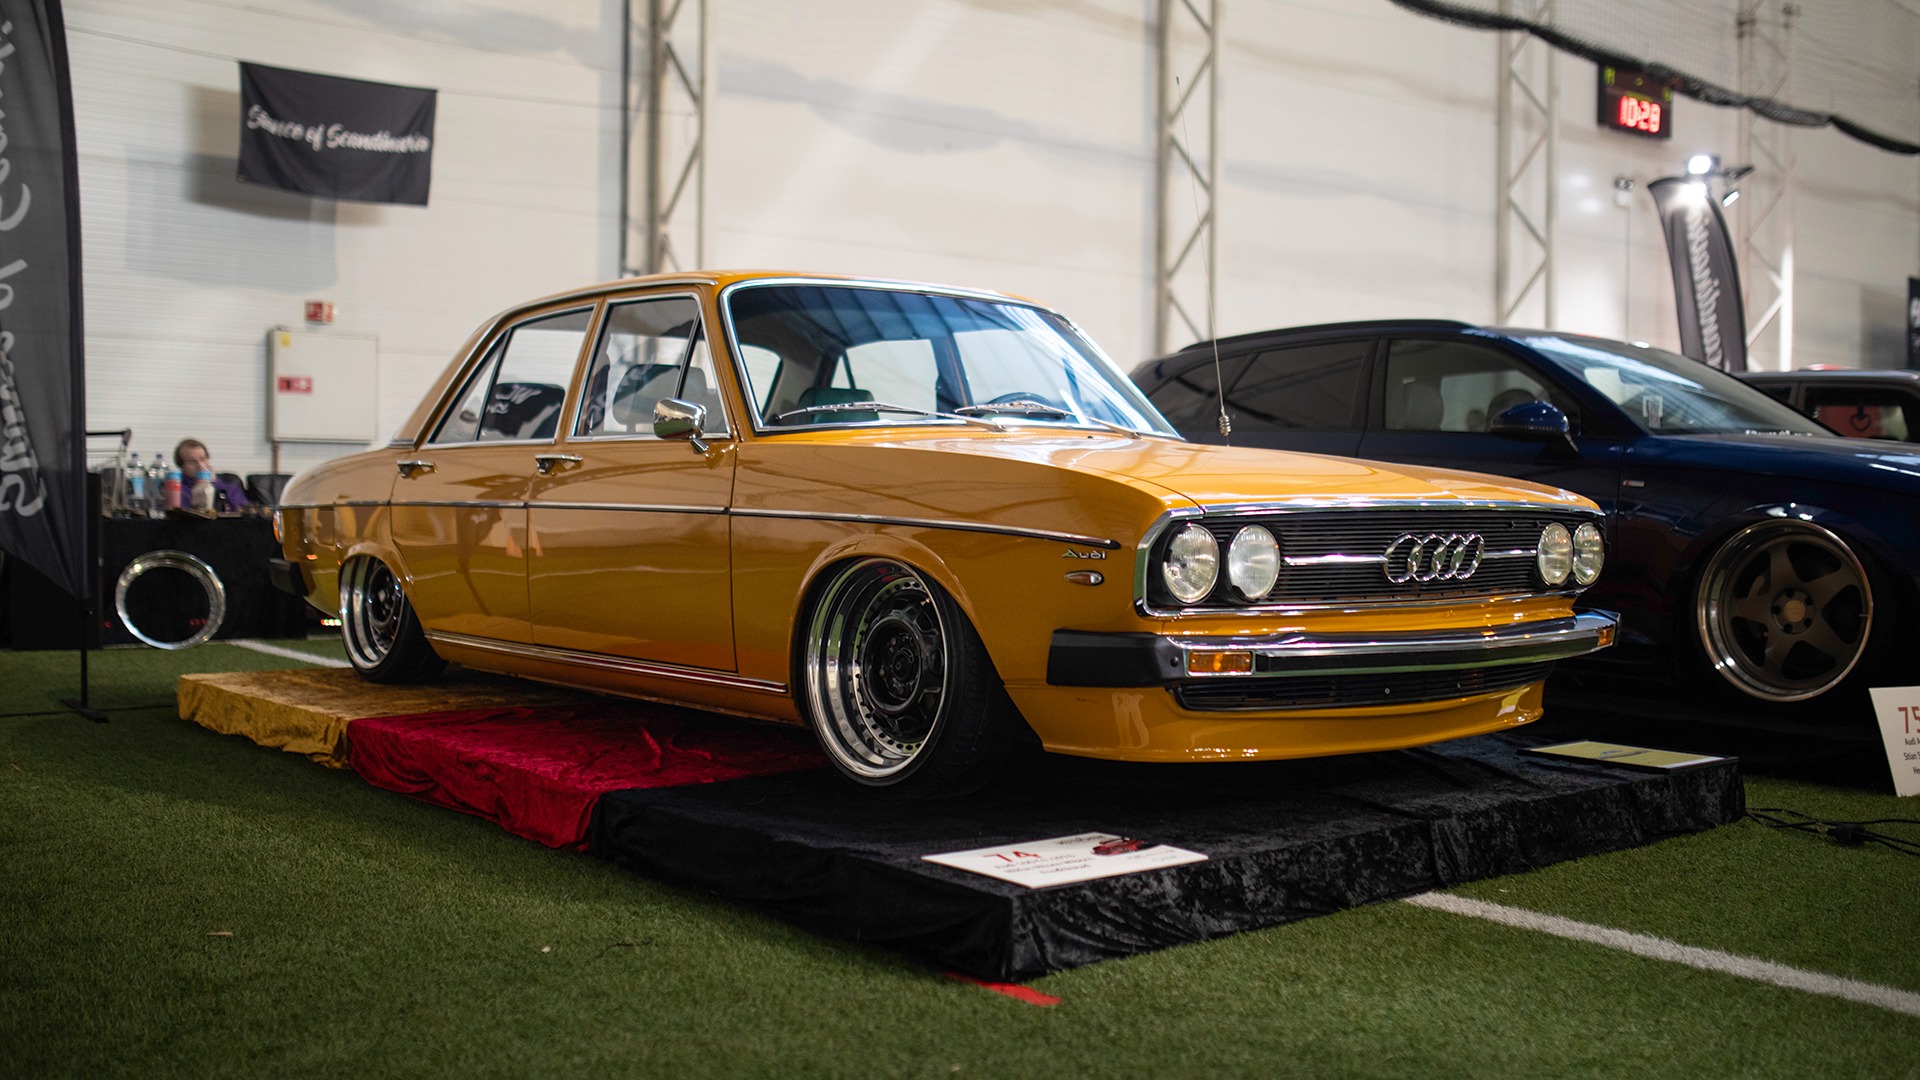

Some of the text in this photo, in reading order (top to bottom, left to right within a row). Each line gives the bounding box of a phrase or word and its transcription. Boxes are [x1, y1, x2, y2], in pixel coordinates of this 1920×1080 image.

[305, 123, 325, 152] of
[1062, 549, 1106, 559] Audi
[982, 851, 1041, 863] 74
